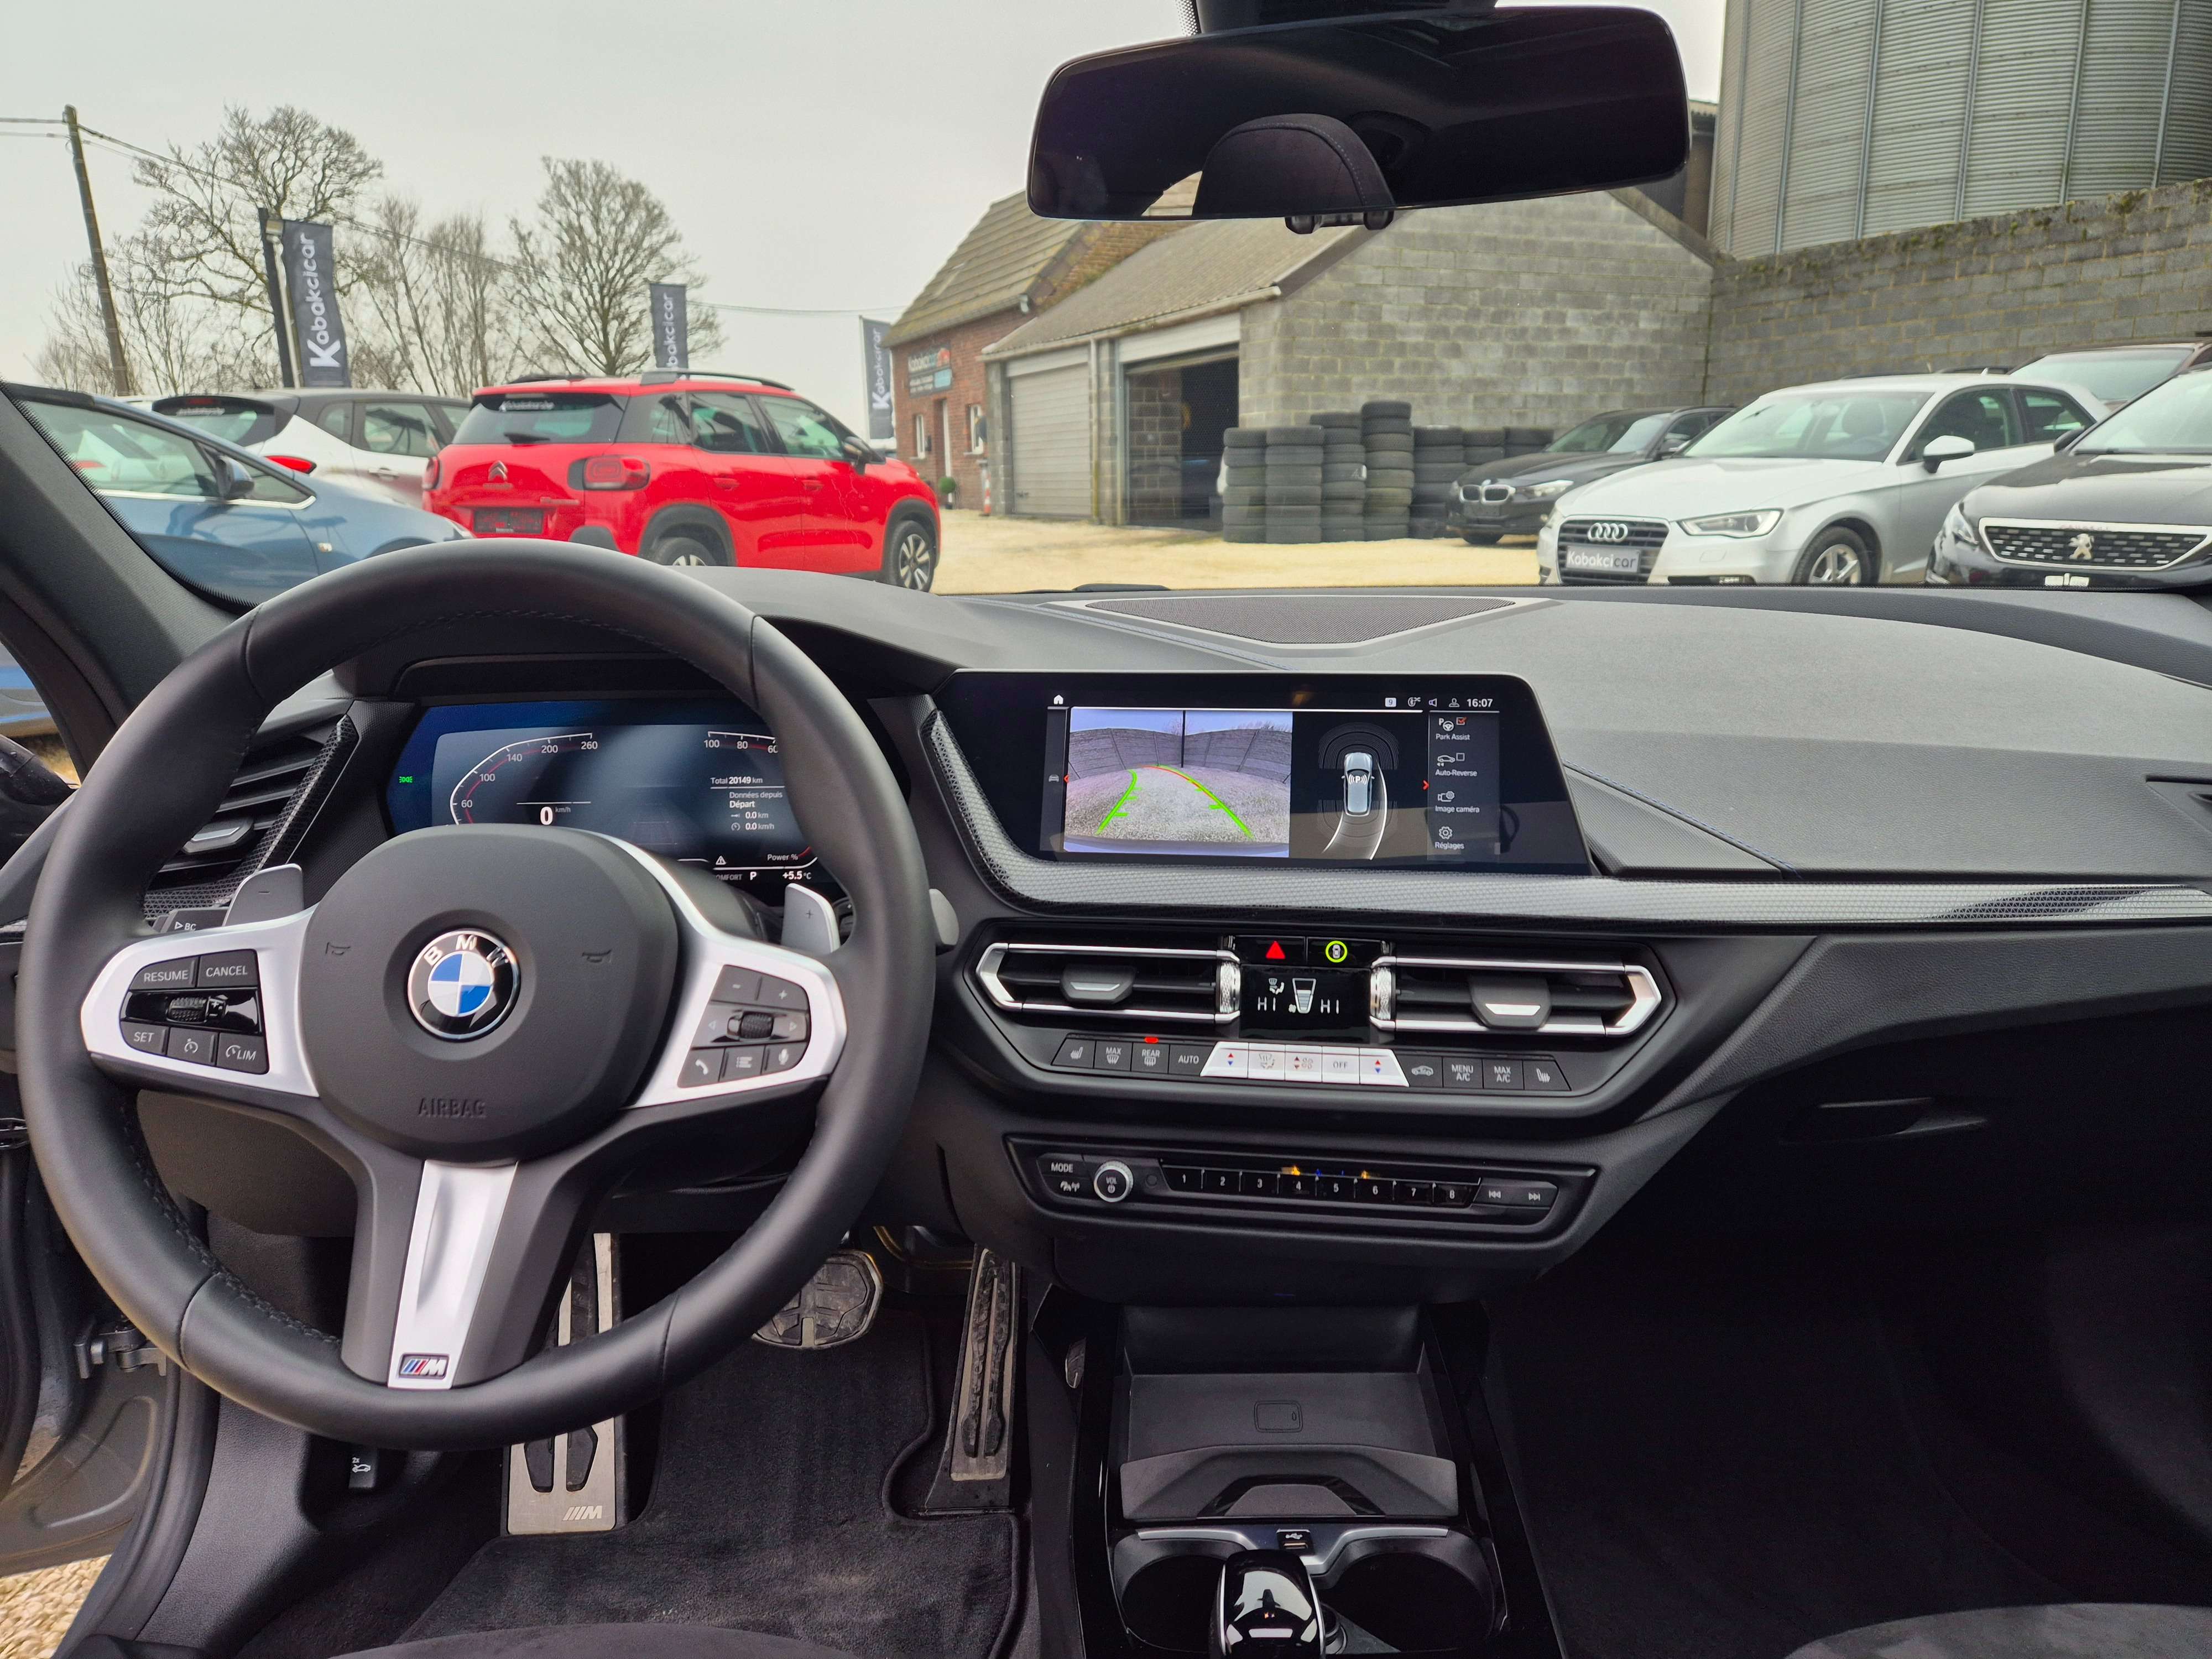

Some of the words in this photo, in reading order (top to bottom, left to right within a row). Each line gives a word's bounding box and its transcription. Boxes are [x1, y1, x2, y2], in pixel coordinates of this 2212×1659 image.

[300, 232, 341, 367] Kabakcicar
[1568, 551, 1637, 568] Kabakcicar
[1467, 698, 1493, 707] 16:07
[581, 741, 598, 750] 260
[704, 739, 719, 748] 100
[737, 741, 748, 749] 80
[541, 745, 558, 753] 200
[507, 753, 522, 761] 140
[728, 776, 752, 784] 20149
[461, 800, 473, 808] 60
[729, 800, 755, 809] Départ
[540, 806, 554, 825] 0
[750, 872, 757, 880] P
[782, 871, 802, 880] +5.5
[424, 934, 509, 968] BMW
[144, 970, 188, 982] RESUME
[206, 966, 248, 978] CANCEL
[134, 1032, 154, 1043] SET
[236, 1048, 257, 1061] LIM
[1106, 1047, 1121, 1055] MAX
[1142, 1049, 1160, 1057] REAR
[1178, 1055, 1199, 1065] AUTO
[1452, 1064, 1474, 1074] MENU
[1494, 1066, 1511, 1074] MAX
[1456, 1072, 1471, 1082] A/C
[1496, 1073, 1511, 1083] A/C
[419, 1098, 486, 1118] AIRBAG
[1051, 1162, 1073, 1173] MODE
[1106, 1176, 1117, 1185] VOL
[1182, 1174, 1186, 1183] 1
[1220, 1176, 1225, 1186] 2
[1258, 1178, 1262, 1188] 3
[1296, 1181, 1301, 1191] 4
[1334, 1183, 1339, 1193] 5
[1373, 1186, 1378, 1195] 6
[1412, 1188, 1417, 1197] 7
[1449, 1190, 1455, 1199] 8
